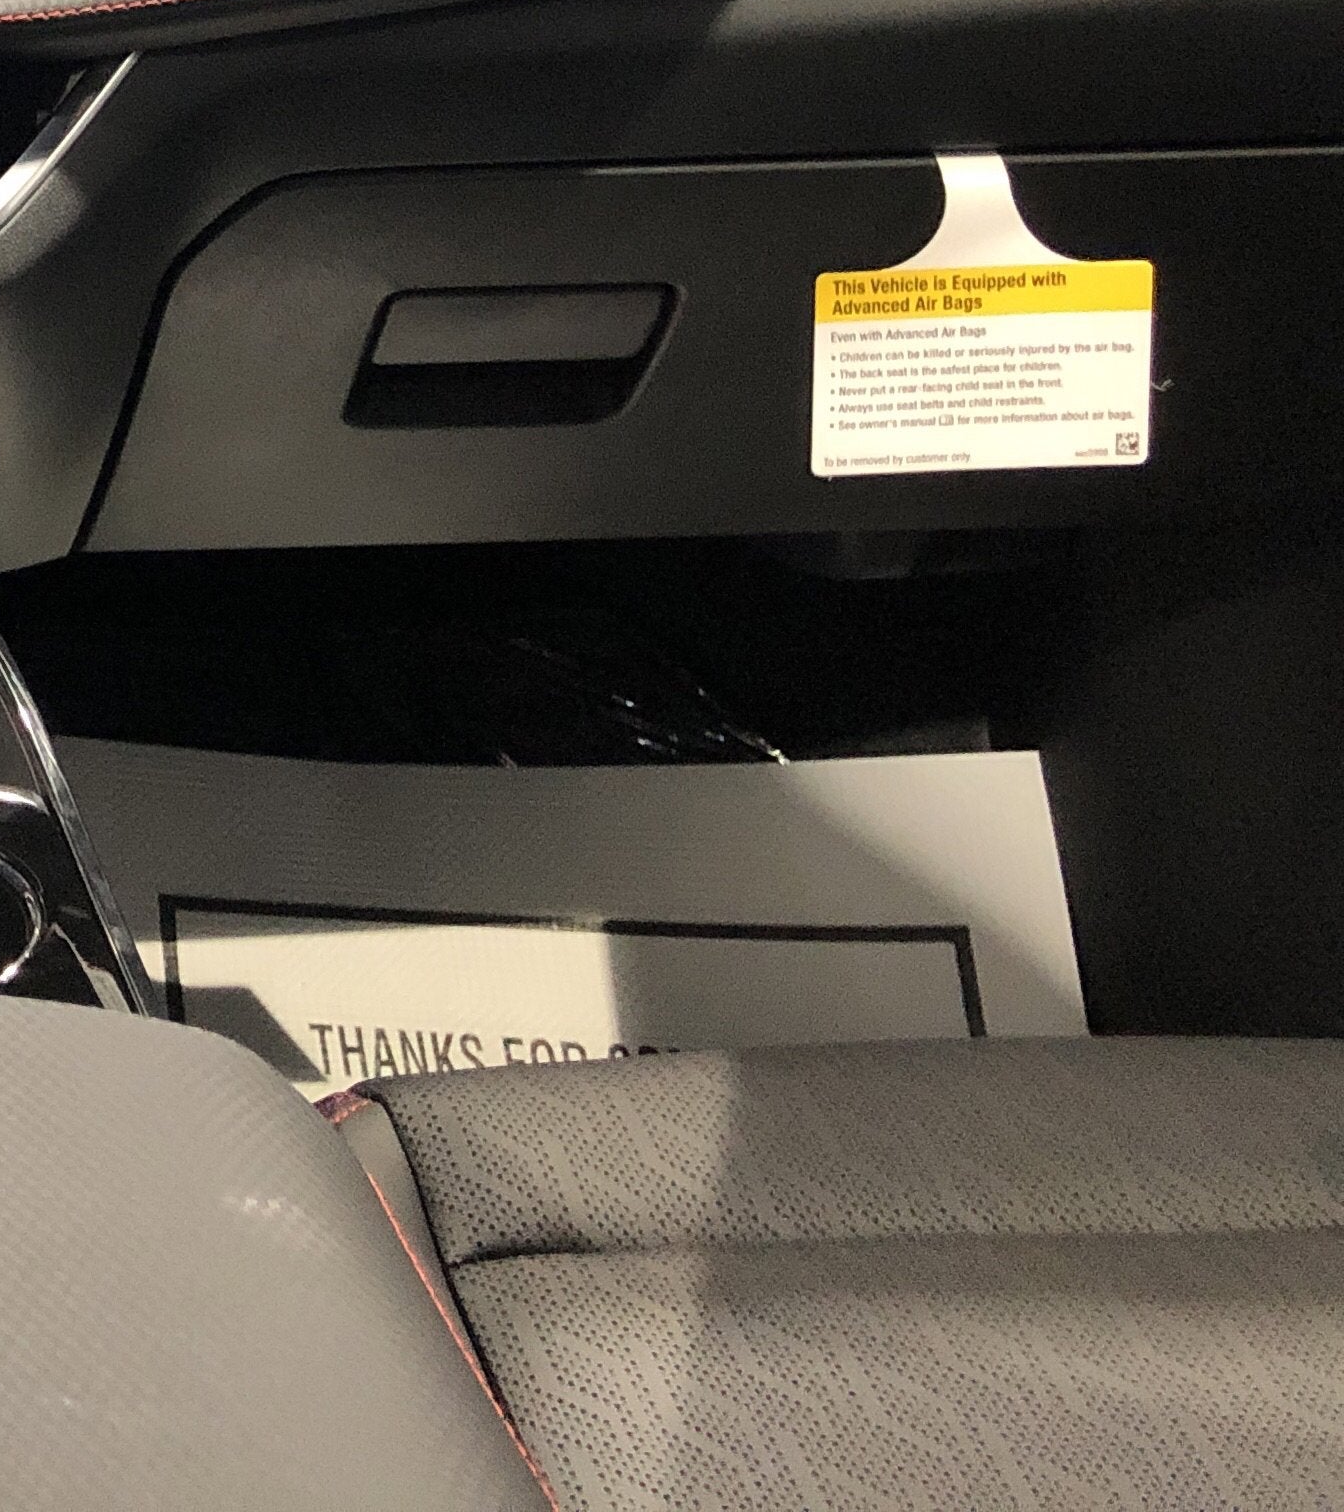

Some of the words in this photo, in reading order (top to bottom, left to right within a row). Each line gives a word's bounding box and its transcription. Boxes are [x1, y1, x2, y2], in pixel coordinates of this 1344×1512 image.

[833, 279, 865, 296] This
[871, 276, 928, 294] Vehicle
[952, 272, 1026, 292] Equipped
[1032, 271, 1067, 287] with
[832, 298, 910, 315] Advanced
[915, 296, 937, 311] Air
[943, 295, 983, 313] Bags
[831, 332, 856, 343] Even
[860, 330, 882, 341] with
[886, 328, 938, 340] Advanced
[942, 327, 955, 337] Air
[960, 326, 986, 338] Bags
[840, 352, 882, 362] Children
[886, 351, 904, 360] can
[924, 348, 951, 359] killed
[955, 349, 965, 357] or
[968, 346, 1015, 358] seriously
[1019, 345, 1055, 356] injured
[1058, 344, 1070, 354] by
[1075, 343, 1091, 352] the
[840, 370, 856, 379] The
[860, 368, 883, 378] back
[887, 368, 907, 377] seat
[922, 366, 936, 375] the
[941, 364, 970, 375] safest
[1003, 362, 1016, 372] for
[839, 386, 866, 396] Never
[870, 385, 886, 397] put
[956, 381, 979, 391] child
[983, 381, 1003, 389] seat
[1019, 379, 1034, 388] the
[838, 403, 873, 414] Always
[897, 401, 917, 411] seat
[921, 399, 944, 410] belts
[947, 399, 965, 409] and
[969, 398, 992, 408] child
[838, 420, 856, 430] See
[901, 417, 936, 427] manual
[1002, 412, 1057, 423] information
[1061, 411, 1089, 421] about
[851, 455, 890, 466] removed
[892, 455, 903, 466] by
[906, 453, 948, 464] customer
[952, 452, 971, 463] only
[308, 1022, 485, 1079] THANKS
